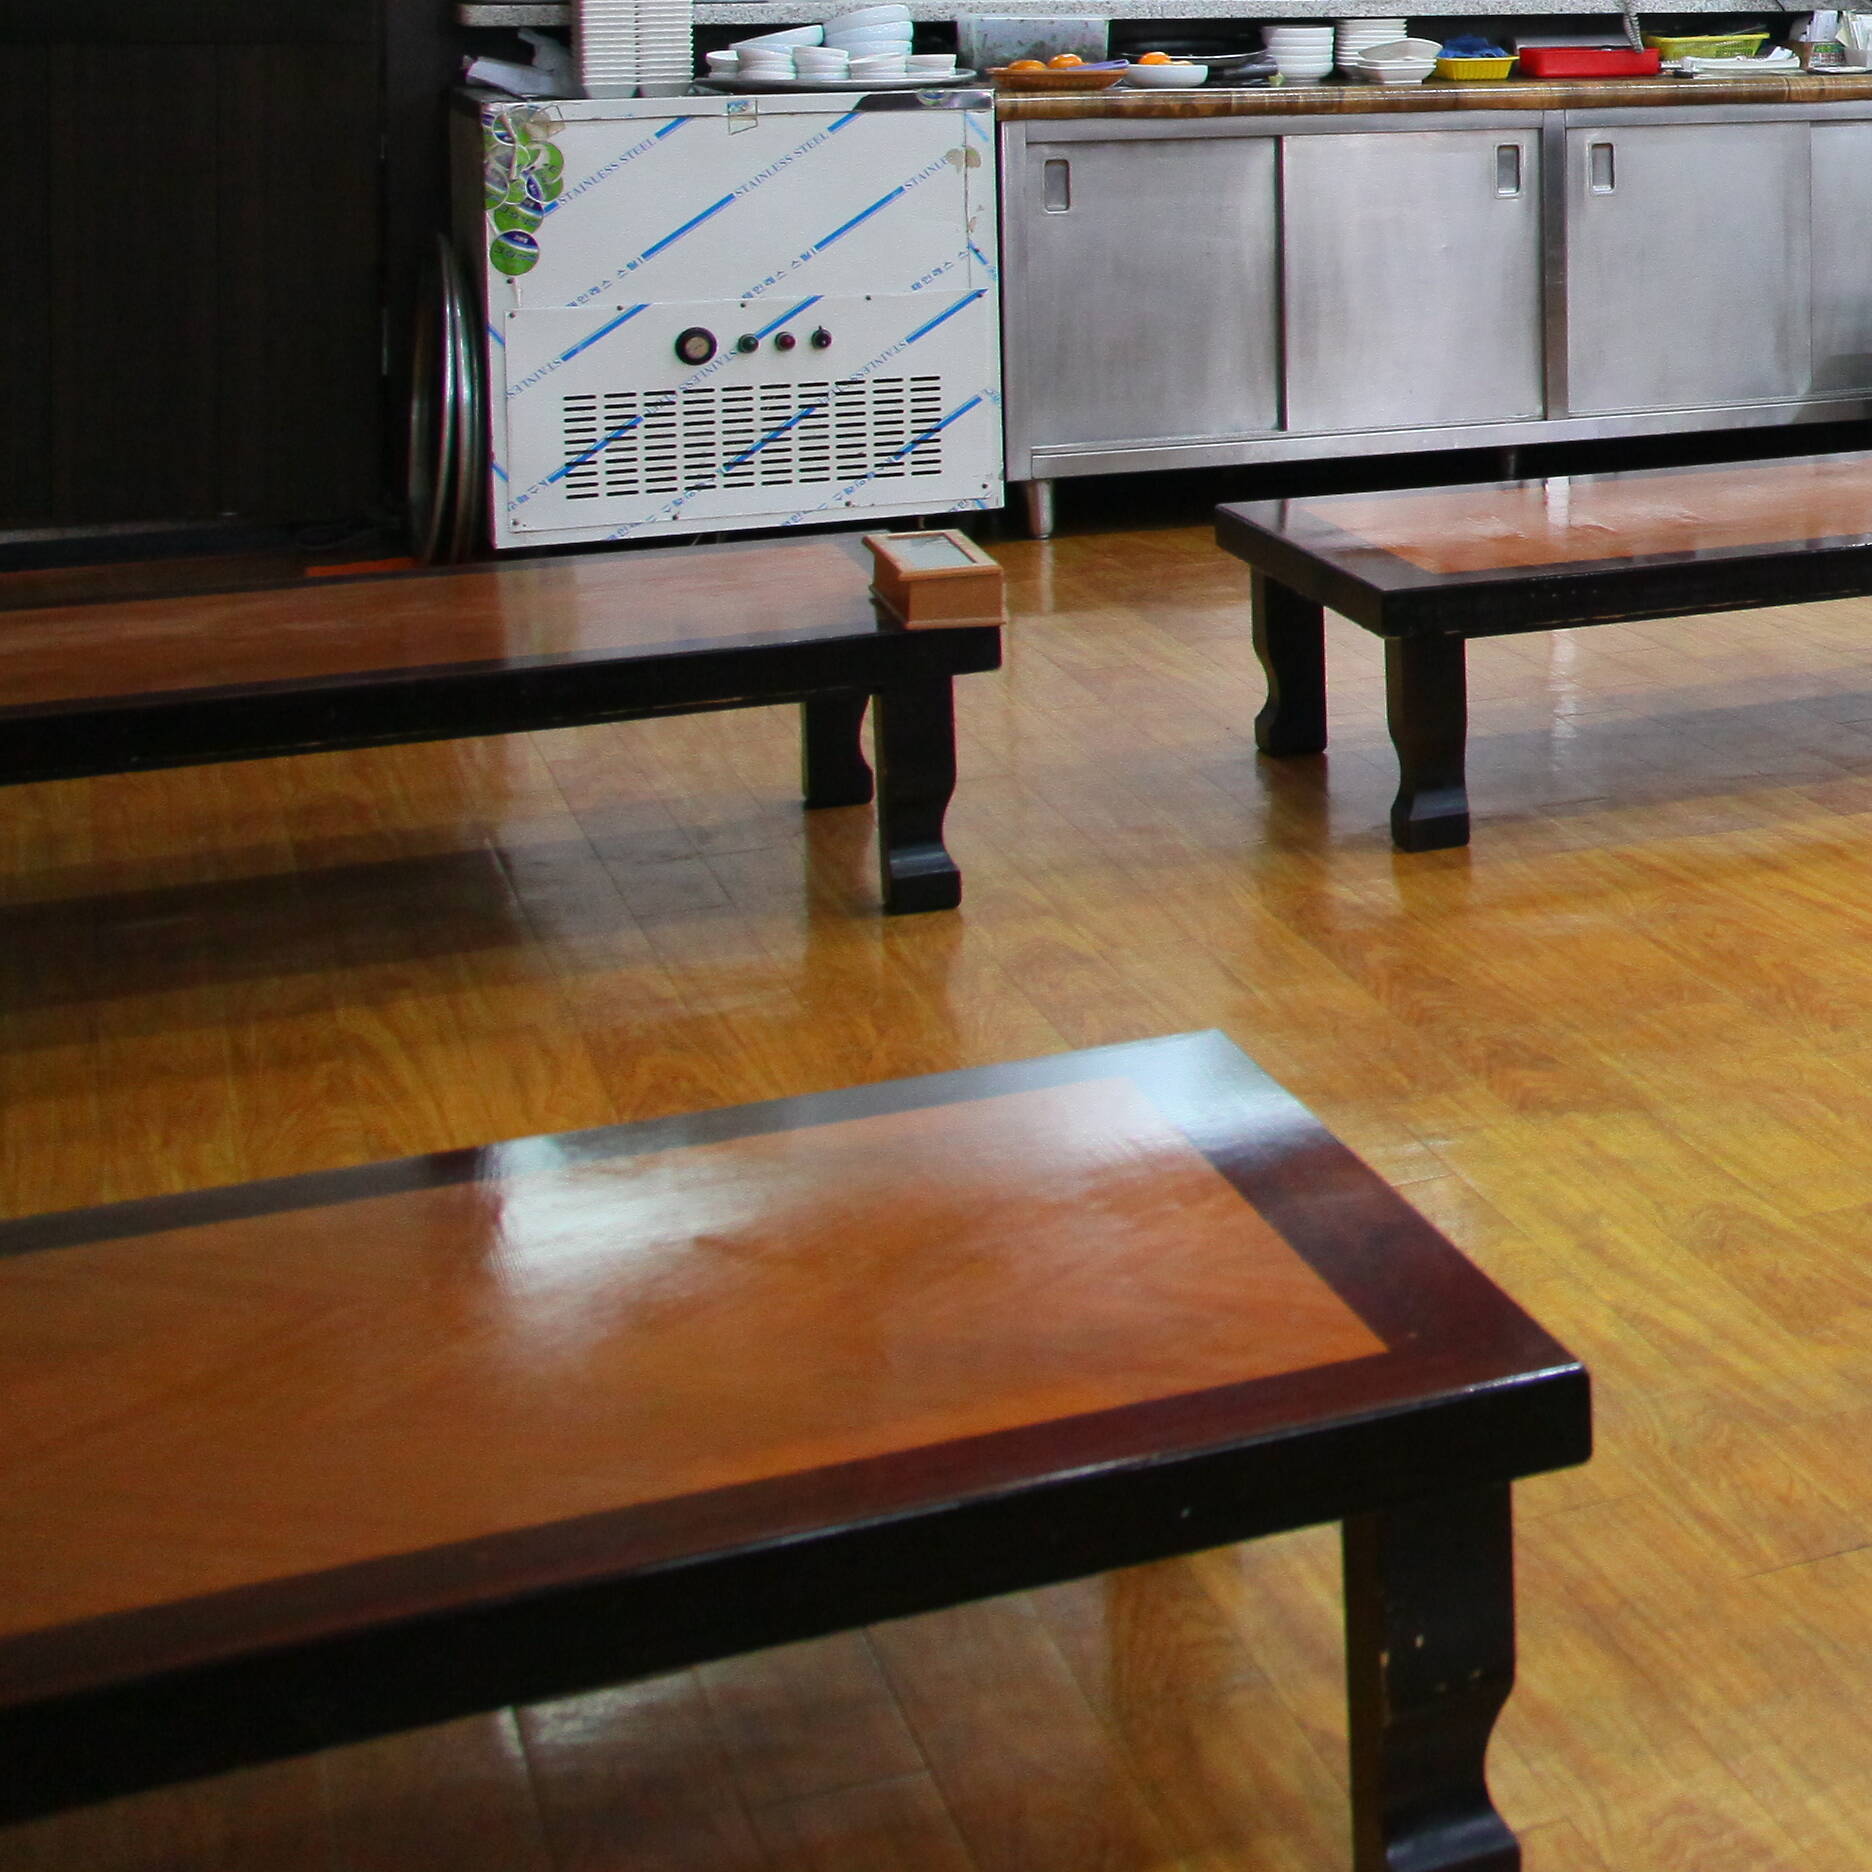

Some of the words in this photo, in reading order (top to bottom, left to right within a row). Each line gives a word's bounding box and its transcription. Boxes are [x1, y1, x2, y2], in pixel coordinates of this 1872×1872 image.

[559, 163, 618, 207] STAINLESS
[619, 139, 657, 165] STEEL
[734, 155, 793, 198] STAINLESS
[794, 132, 829, 158] STEEL
